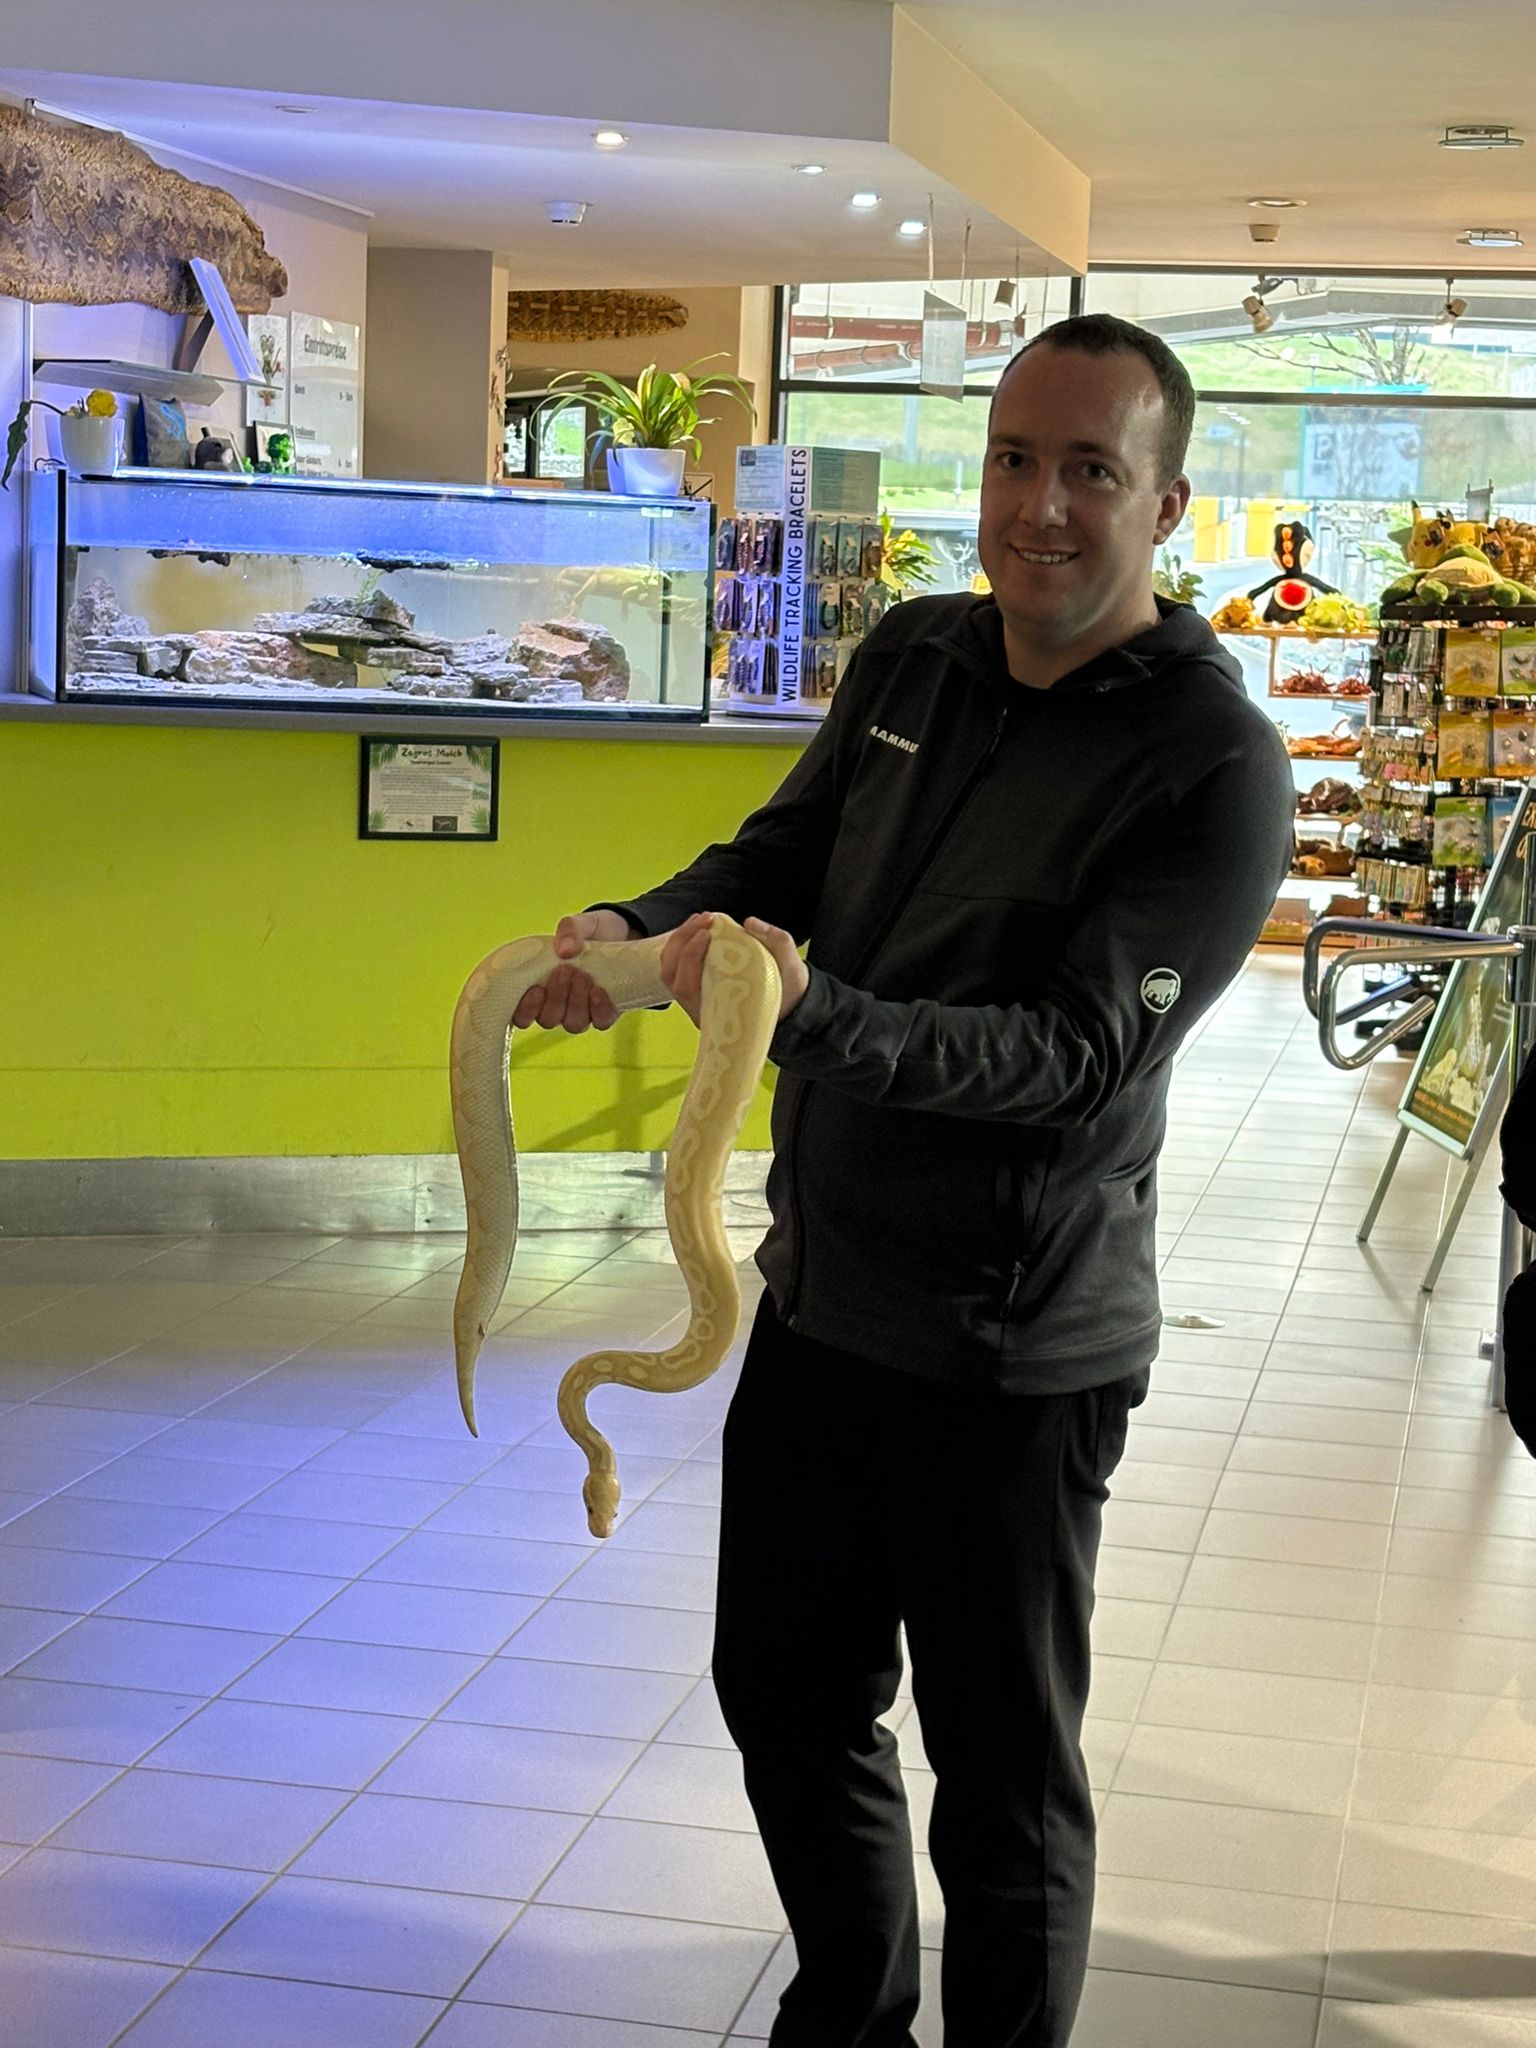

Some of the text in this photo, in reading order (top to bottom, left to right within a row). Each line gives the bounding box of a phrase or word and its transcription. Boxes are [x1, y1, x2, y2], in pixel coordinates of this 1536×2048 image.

[782, 449, 807, 702] WILDLIFE TRACKING BRACELETS
